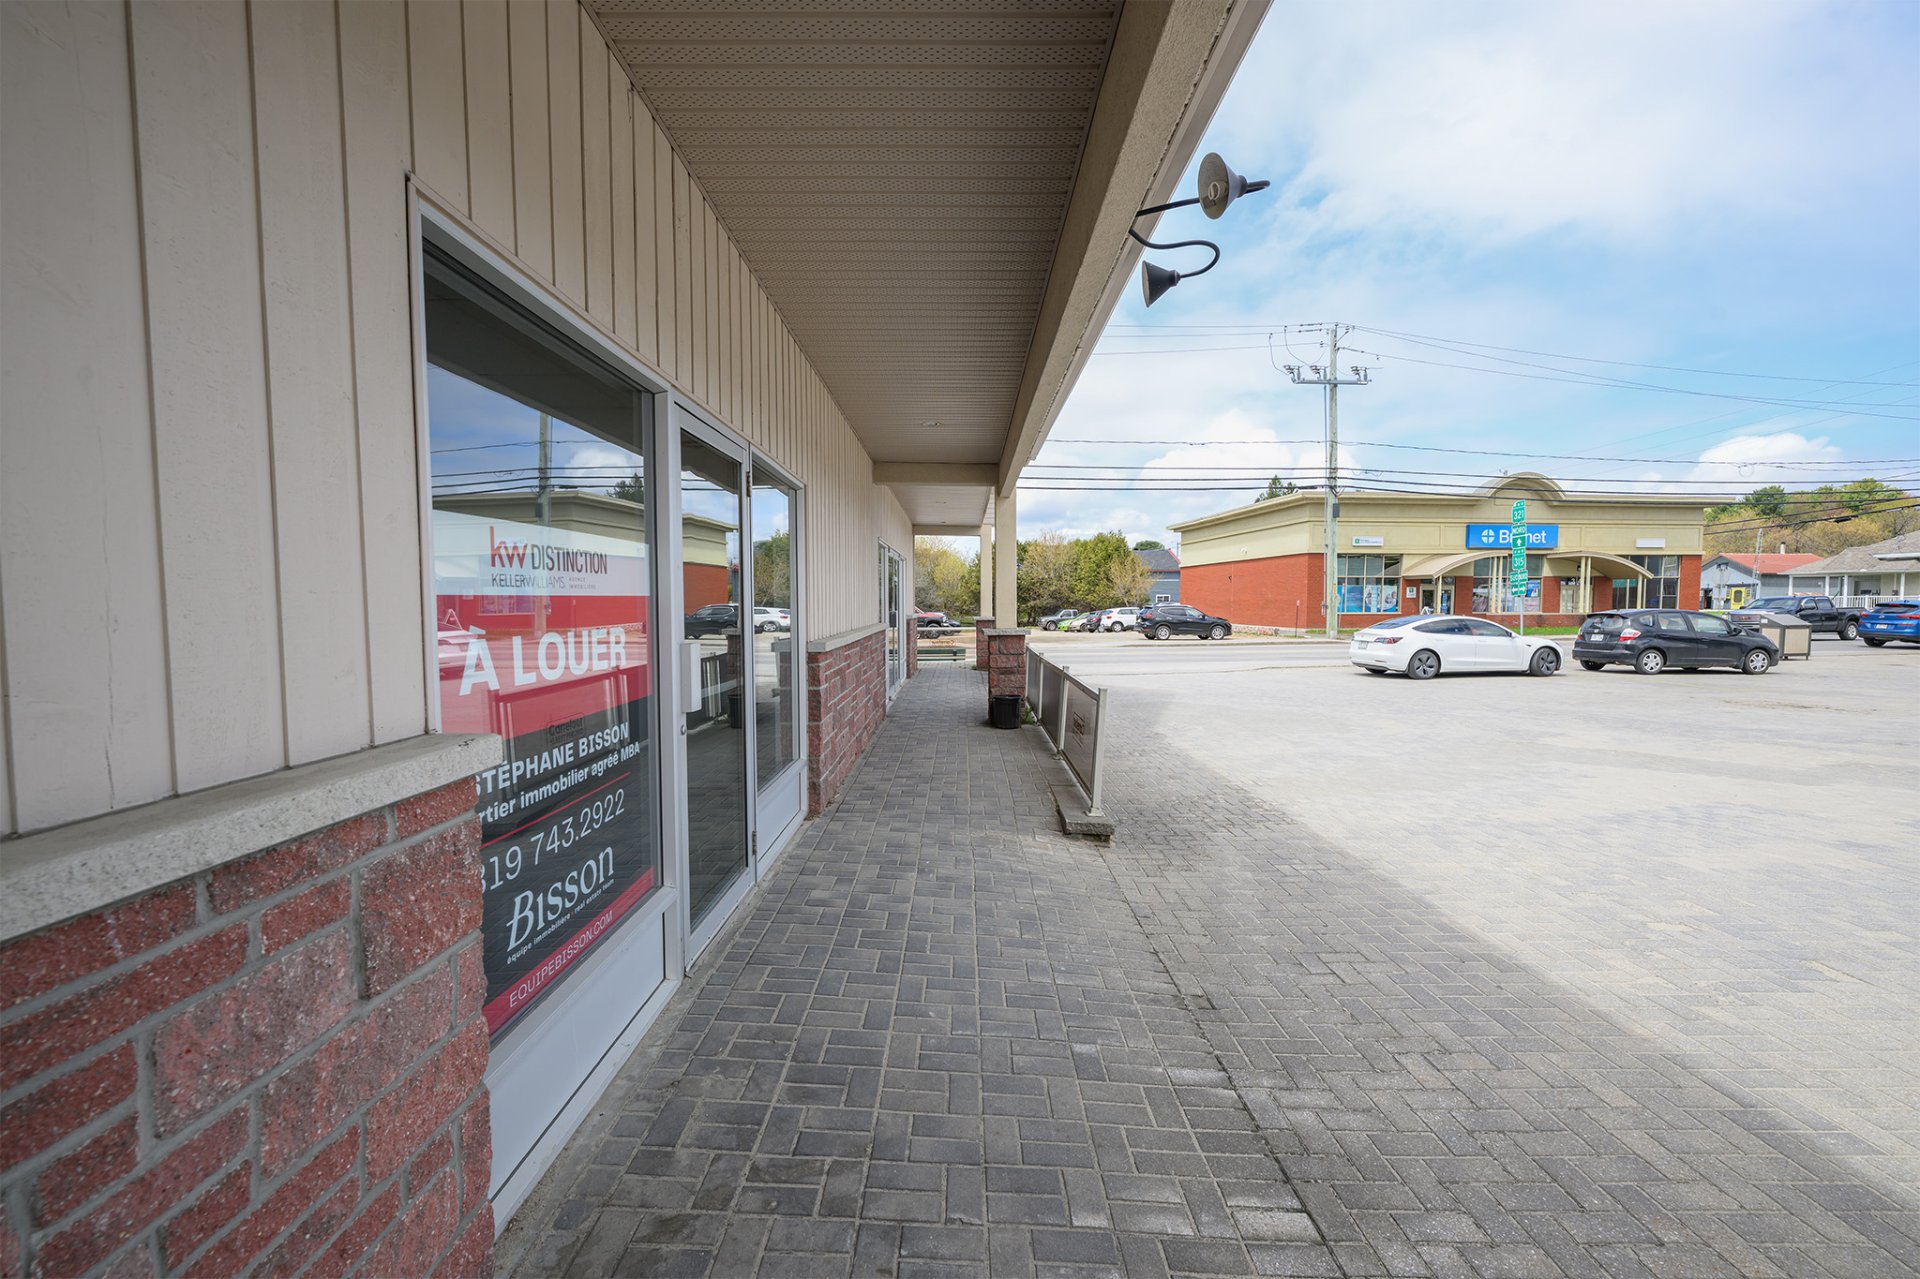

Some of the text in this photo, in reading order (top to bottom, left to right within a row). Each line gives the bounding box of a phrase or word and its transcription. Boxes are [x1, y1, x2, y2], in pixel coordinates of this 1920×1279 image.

[1512, 526, 1525, 535] NORD
[1513, 510, 1524, 520] 321
[490, 526, 608, 574] kw DISTINCTION
[1513, 558, 1525, 567] 315
[459, 625, 627, 697] À LOUER
[578, 722, 629, 758] BISSON
[520, 769, 589, 809] immobilier
[591, 752, 619, 777] agréé
[620, 741, 641, 763] MBA
[530, 789, 625, 865] 743.2922
[507, 943, 533, 964] équipe
[509, 910, 613, 1008] EQUIPEBISSON.COM
